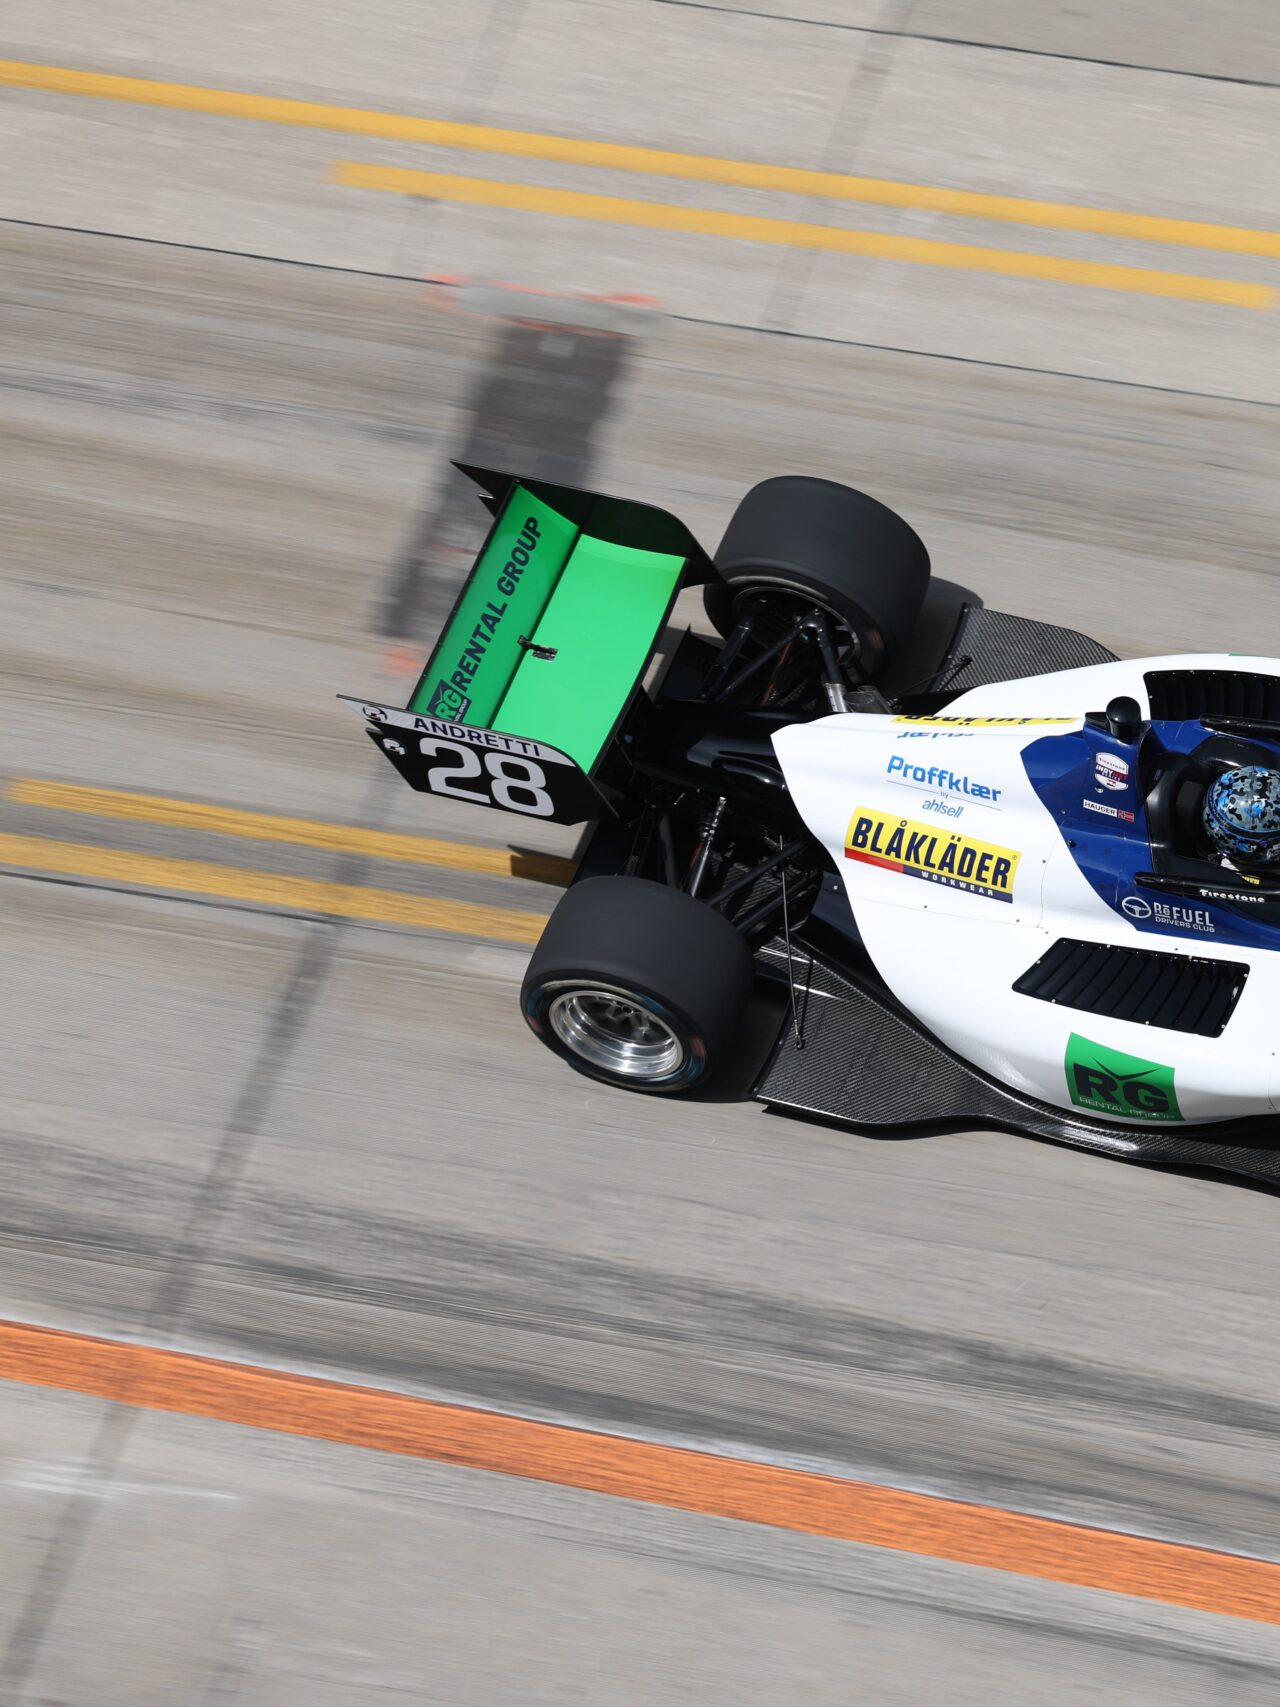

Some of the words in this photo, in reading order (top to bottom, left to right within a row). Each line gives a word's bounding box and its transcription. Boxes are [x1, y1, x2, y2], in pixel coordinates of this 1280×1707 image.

[450, 601, 508, 692] RENTAL
[496, 516, 542, 597] GROUP
[434, 688, 463, 721] RG
[414, 717, 540, 758] ANDRETTI
[419, 737, 555, 817] 28
[887, 755, 1002, 802] Proffklær
[922, 799, 964, 818] ahlsell
[1084, 801, 1116, 816] HAUGER
[851, 816, 1013, 889] BLÅKLÄDER
[921, 871, 994, 897] WORKWEAR
[1200, 889, 1265, 903] Firestone
[1155, 916, 1191, 929] DRIVERS
[1193, 921, 1215, 933] CLUB
[1073, 1062, 1169, 1112] RG
[1080, 1096, 1125, 1113] RENTAL
